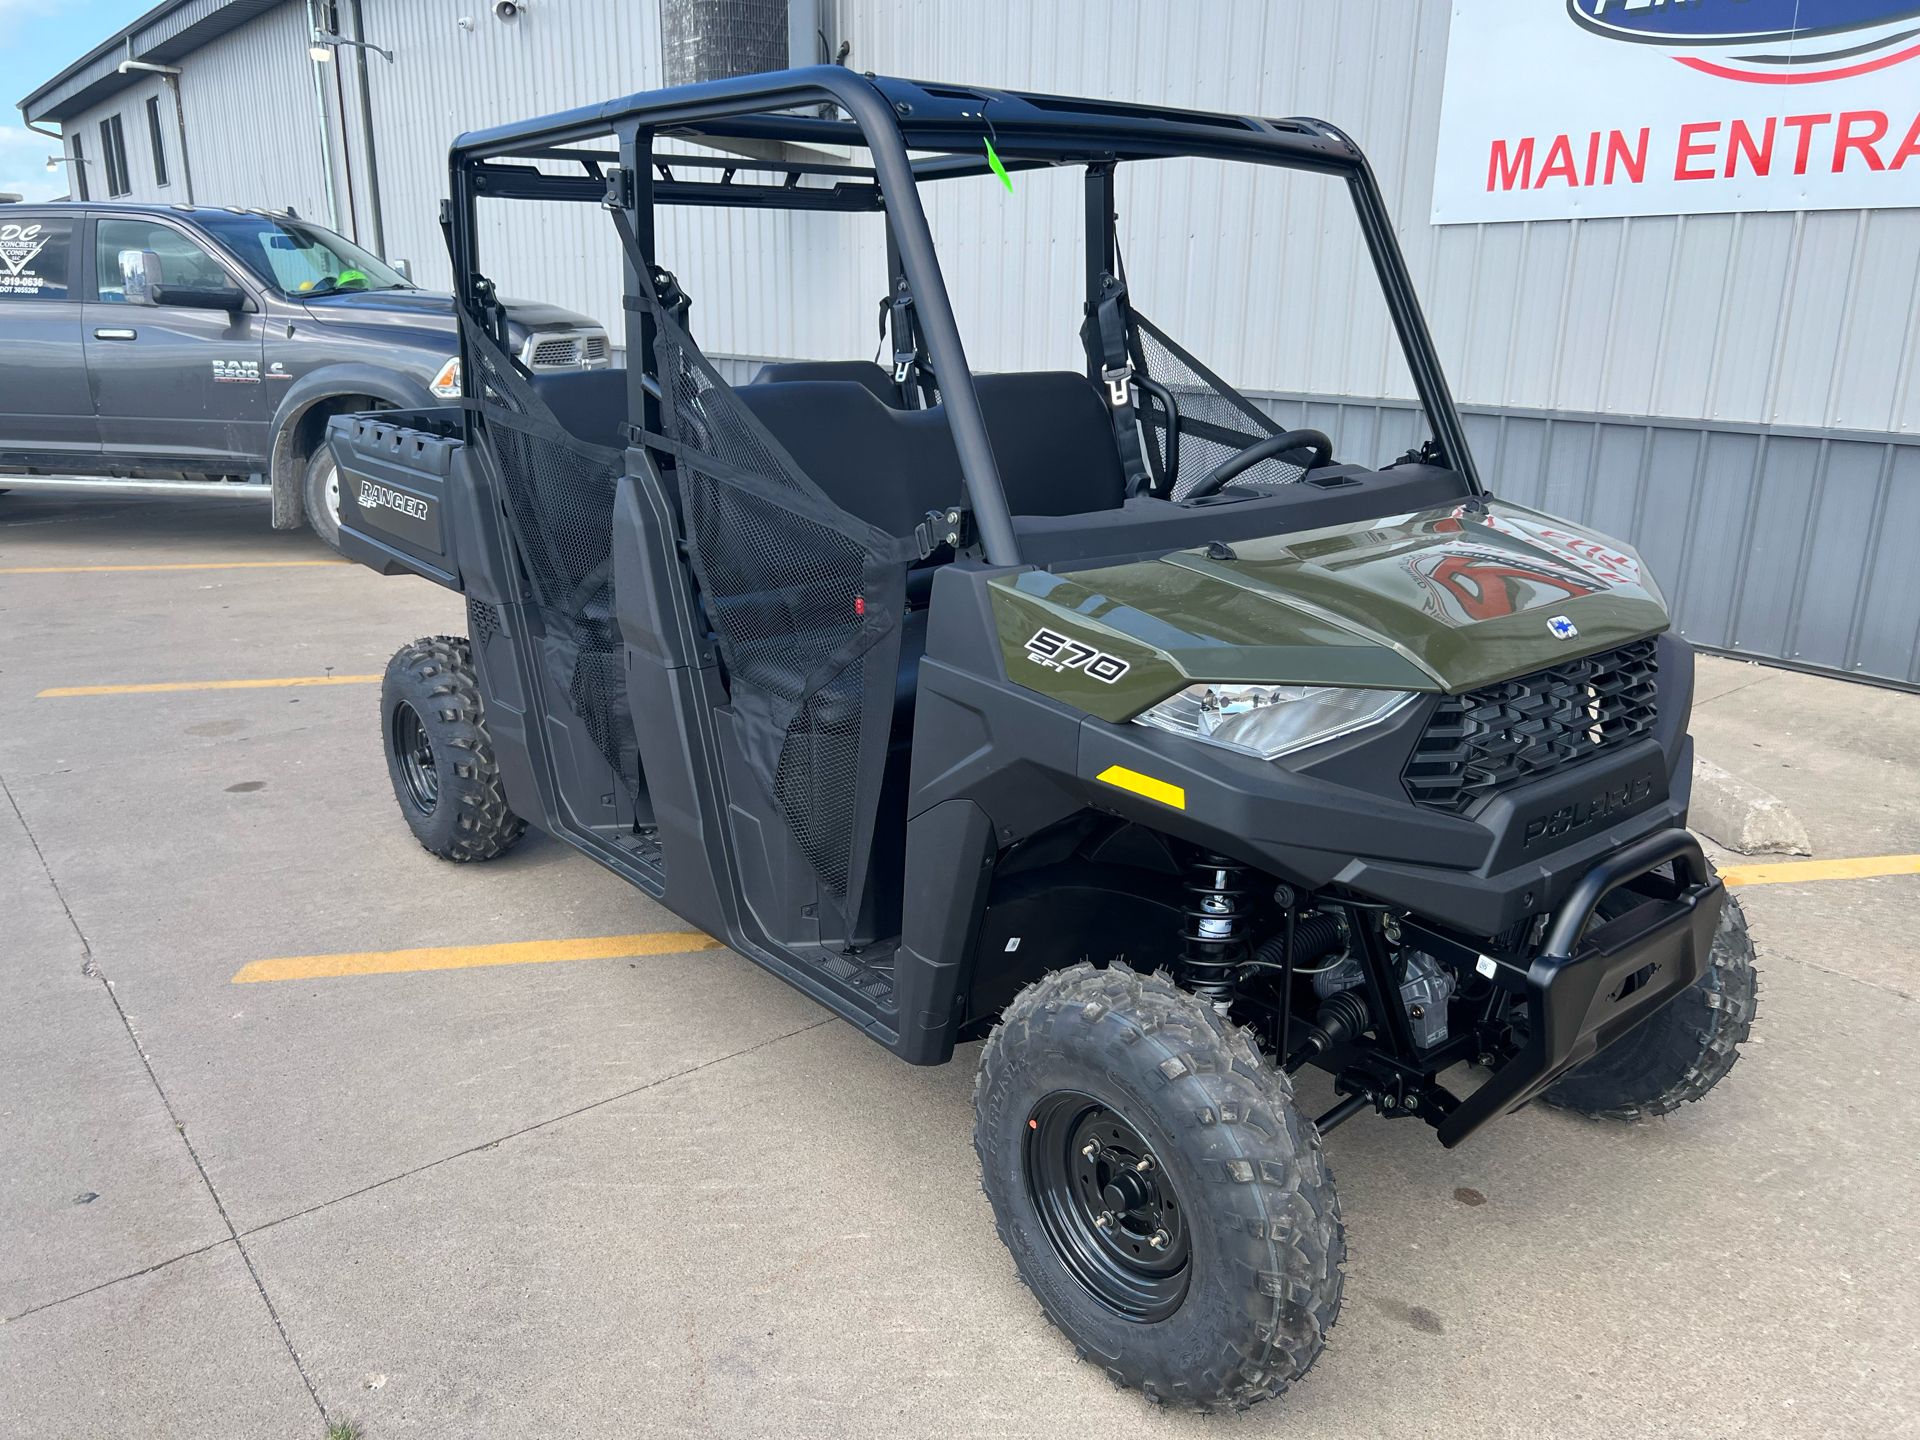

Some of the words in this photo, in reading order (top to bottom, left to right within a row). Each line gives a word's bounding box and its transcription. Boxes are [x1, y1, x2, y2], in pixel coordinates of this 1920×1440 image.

[1486, 127, 1650, 192] MAIN
[1, 224, 42, 241] DC
[212, 360, 258, 370] RAM
[213, 369, 259, 377] 5500
[358, 496, 377, 508] SP
[361, 480, 428, 521] RANGER
[1024, 627, 1131, 685] 570
[1027, 652, 1065, 673] EFI
[1523, 774, 1652, 849] POLARIS
